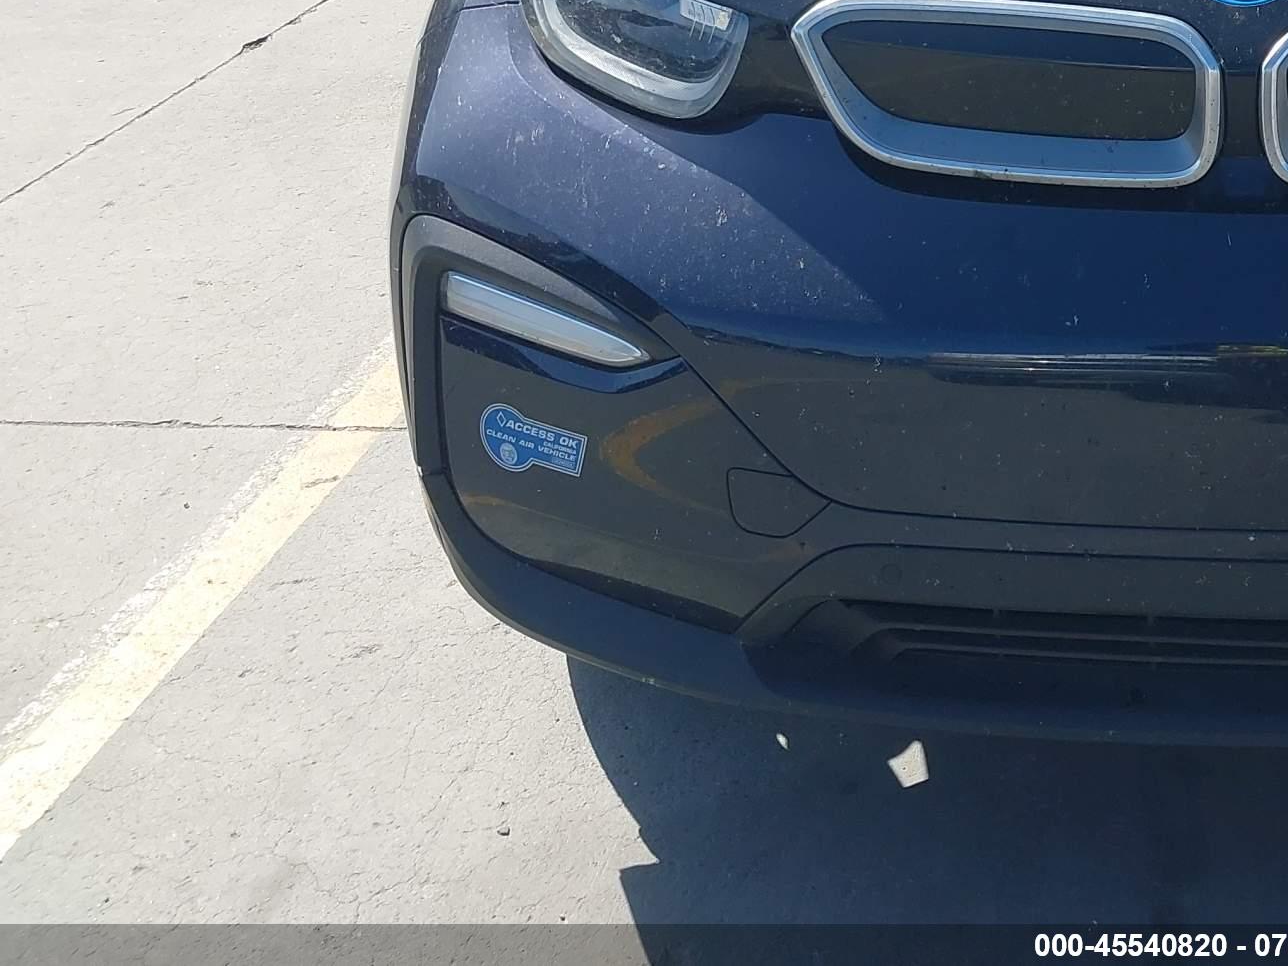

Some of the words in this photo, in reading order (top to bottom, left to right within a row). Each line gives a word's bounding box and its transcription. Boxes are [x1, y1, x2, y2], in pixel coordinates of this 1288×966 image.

[486, 429, 517, 443] CLEAN
[519, 439, 535, 449] AIR
[538, 445, 577, 461] VEHICLE
[506, 419, 555, 442] ACCESS
[560, 436, 578, 449] OK
